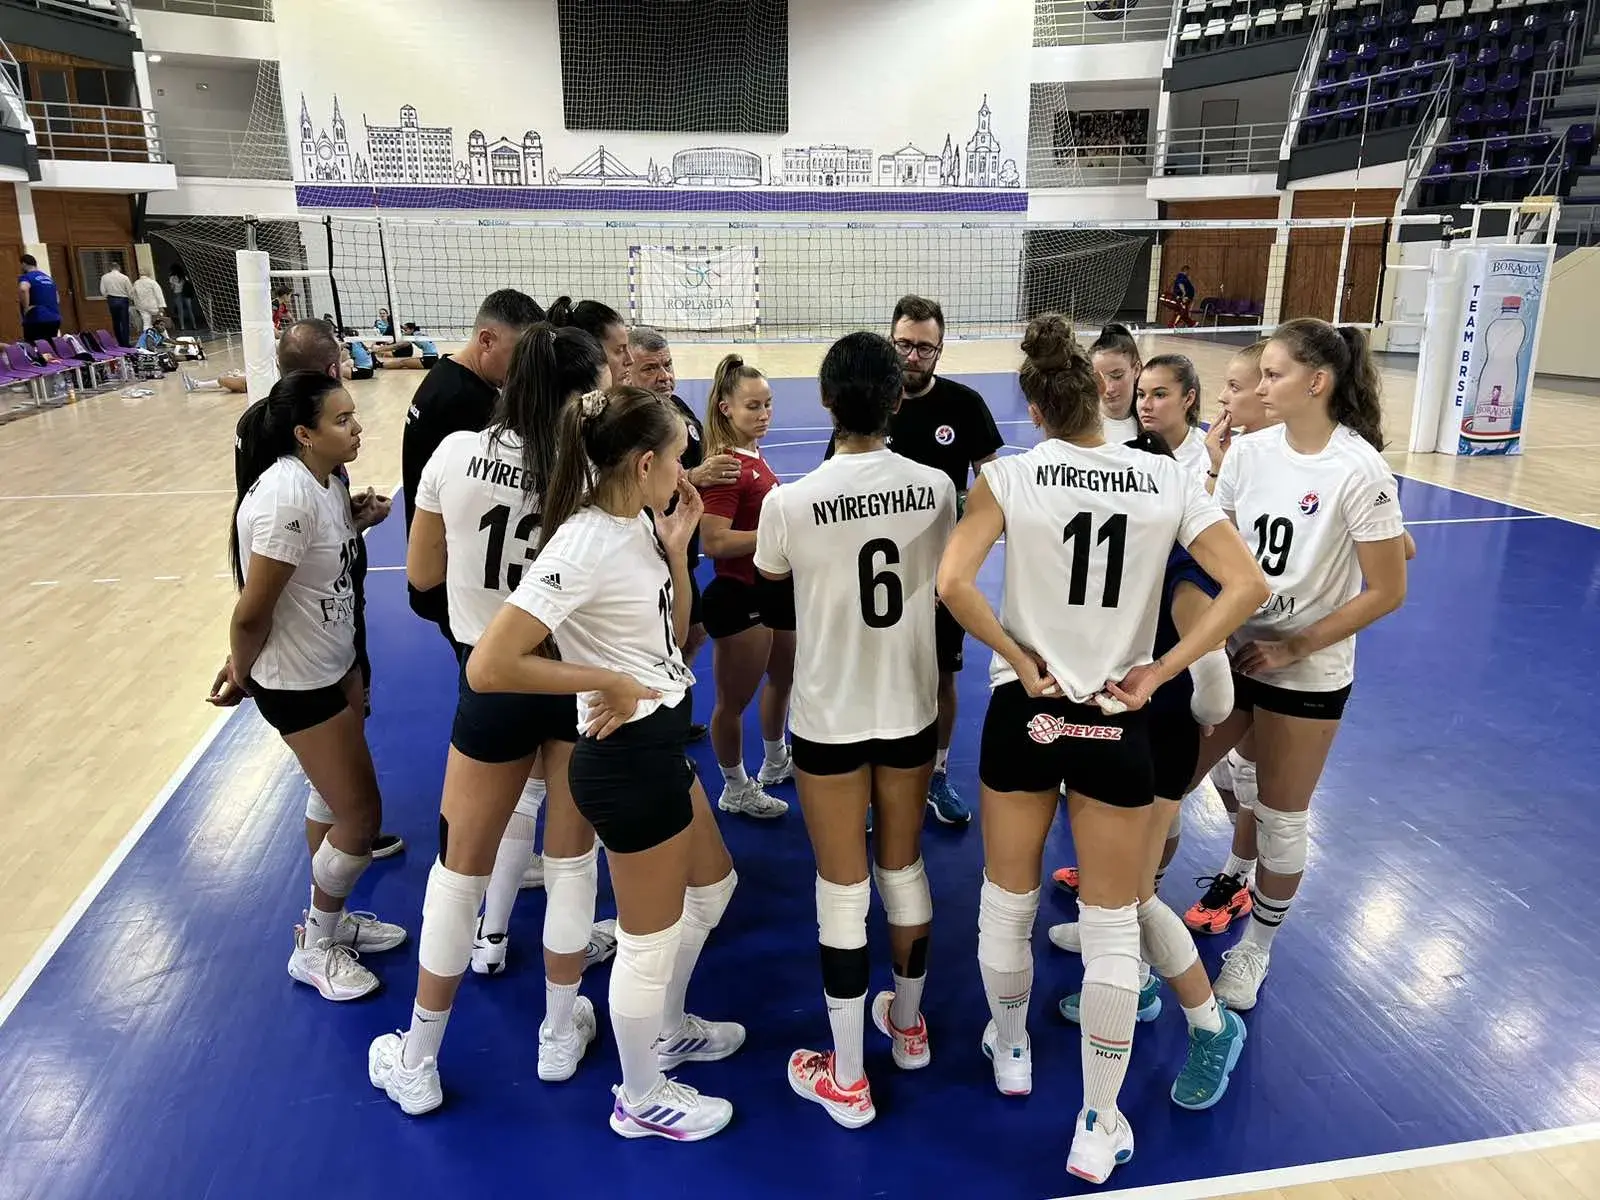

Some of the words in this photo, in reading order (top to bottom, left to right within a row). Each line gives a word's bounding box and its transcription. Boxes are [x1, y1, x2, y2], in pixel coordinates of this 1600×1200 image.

[1492, 262, 1541, 275] BORAQUA
[1463, 285, 1480, 342] TEAM
[1455, 351, 1470, 406] BRSE
[466, 456, 538, 492] NYÍREG
[1036, 463, 1159, 494] NYÍREGYHÁZA
[812, 485, 936, 525] NYÍREGYHÁZA
[1063, 511, 1128, 608] 11
[1254, 513, 1294, 576] 19
[540, 577, 562, 591] adidas
[858, 537, 903, 628] 6
[319, 596, 354, 623] FAT
[1061, 724, 1122, 740] REVESZ
[1095, 1049, 1123, 1060] HUN
